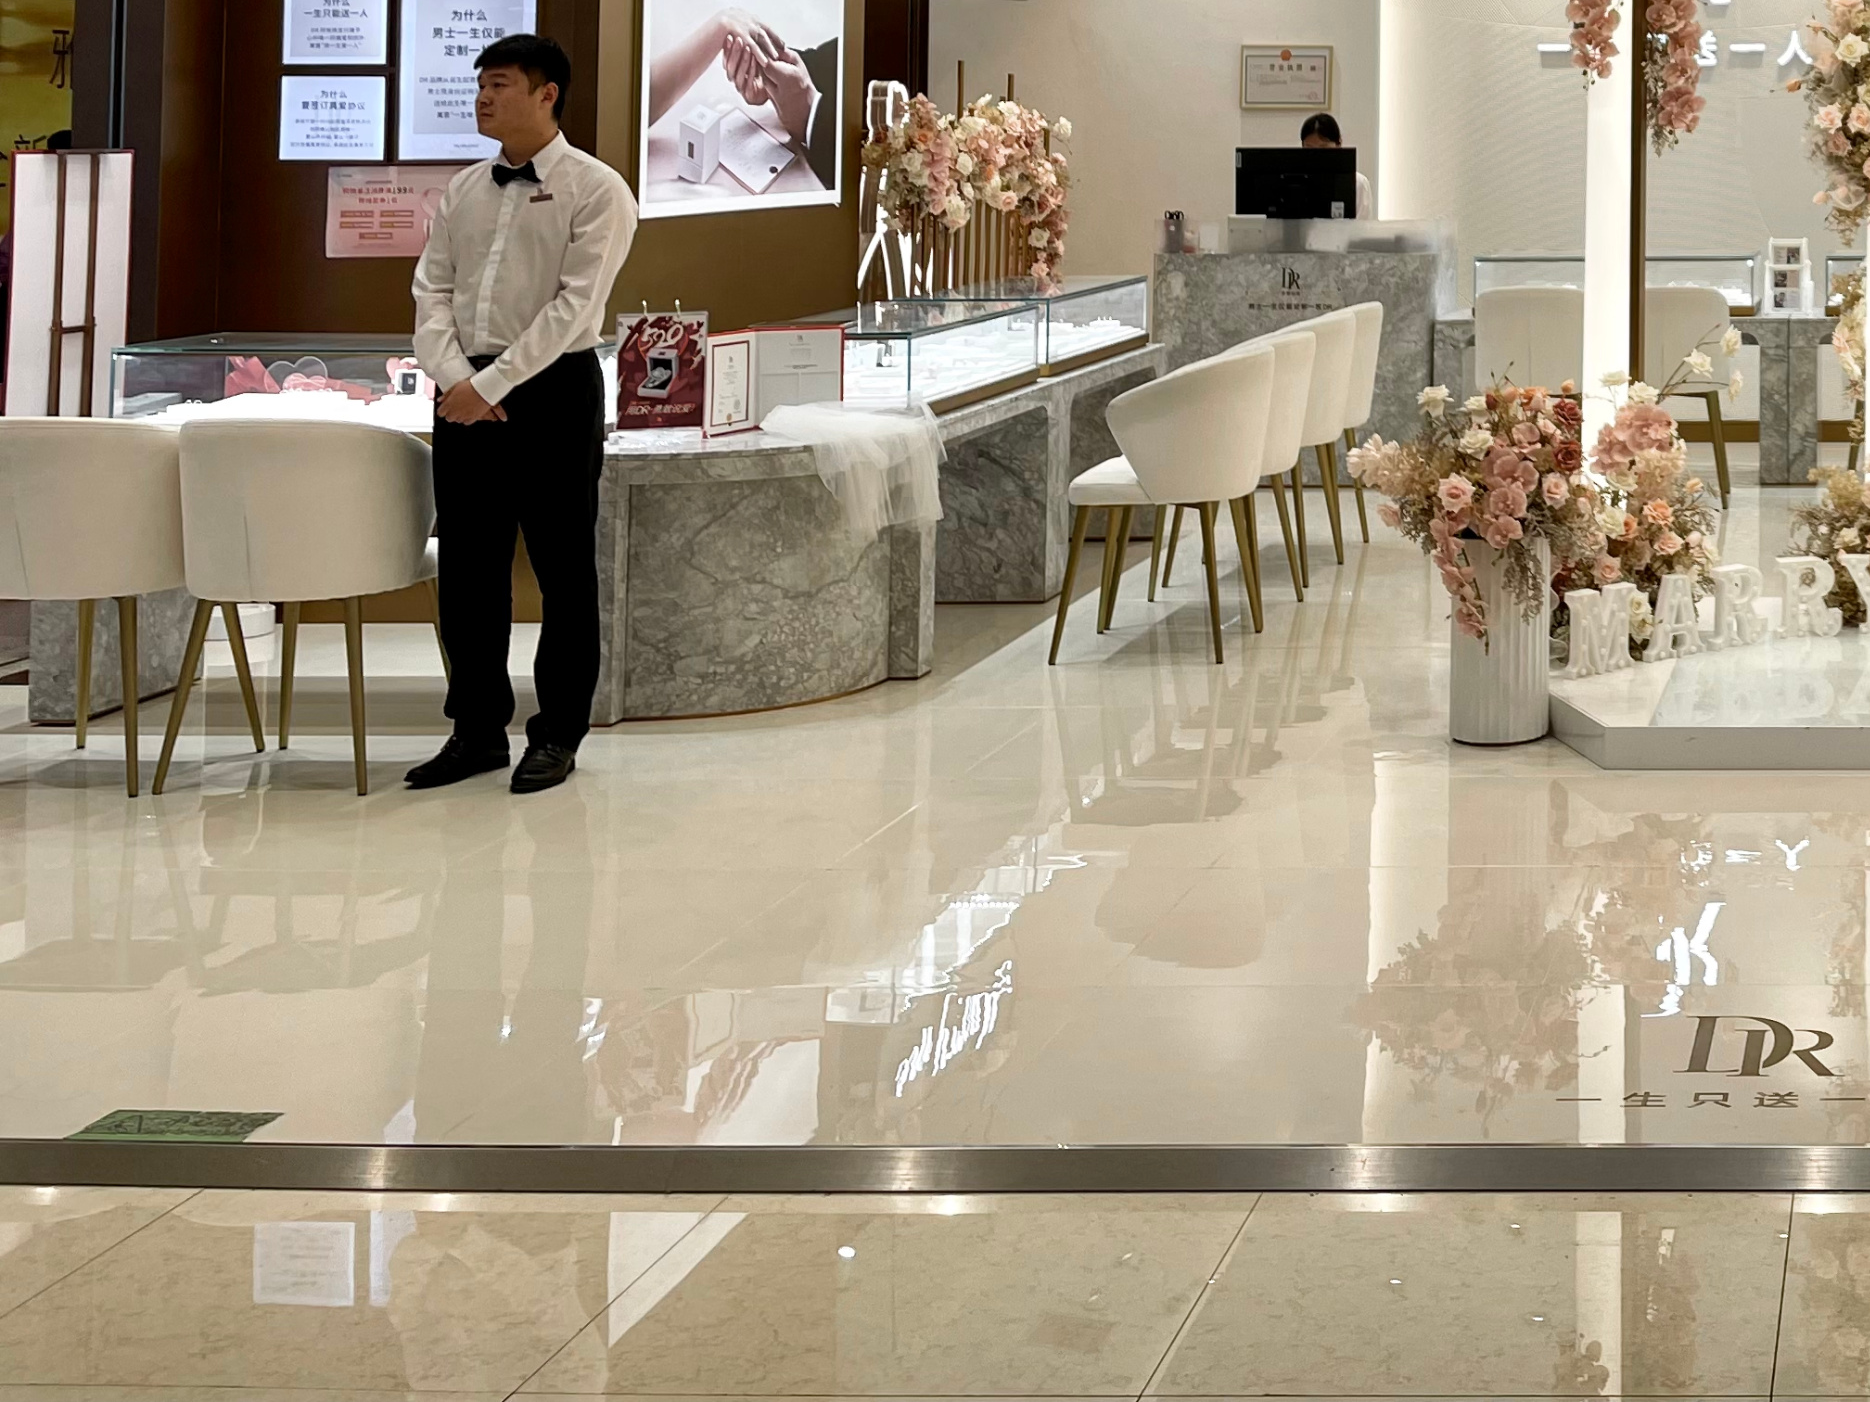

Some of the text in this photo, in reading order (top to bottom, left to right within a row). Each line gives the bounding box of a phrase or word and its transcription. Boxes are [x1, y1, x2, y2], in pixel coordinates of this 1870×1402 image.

[451, 9, 488, 22] 为什么
[1281, 266, 1301, 290] DR
[1672, 1015, 1846, 1078] DR
